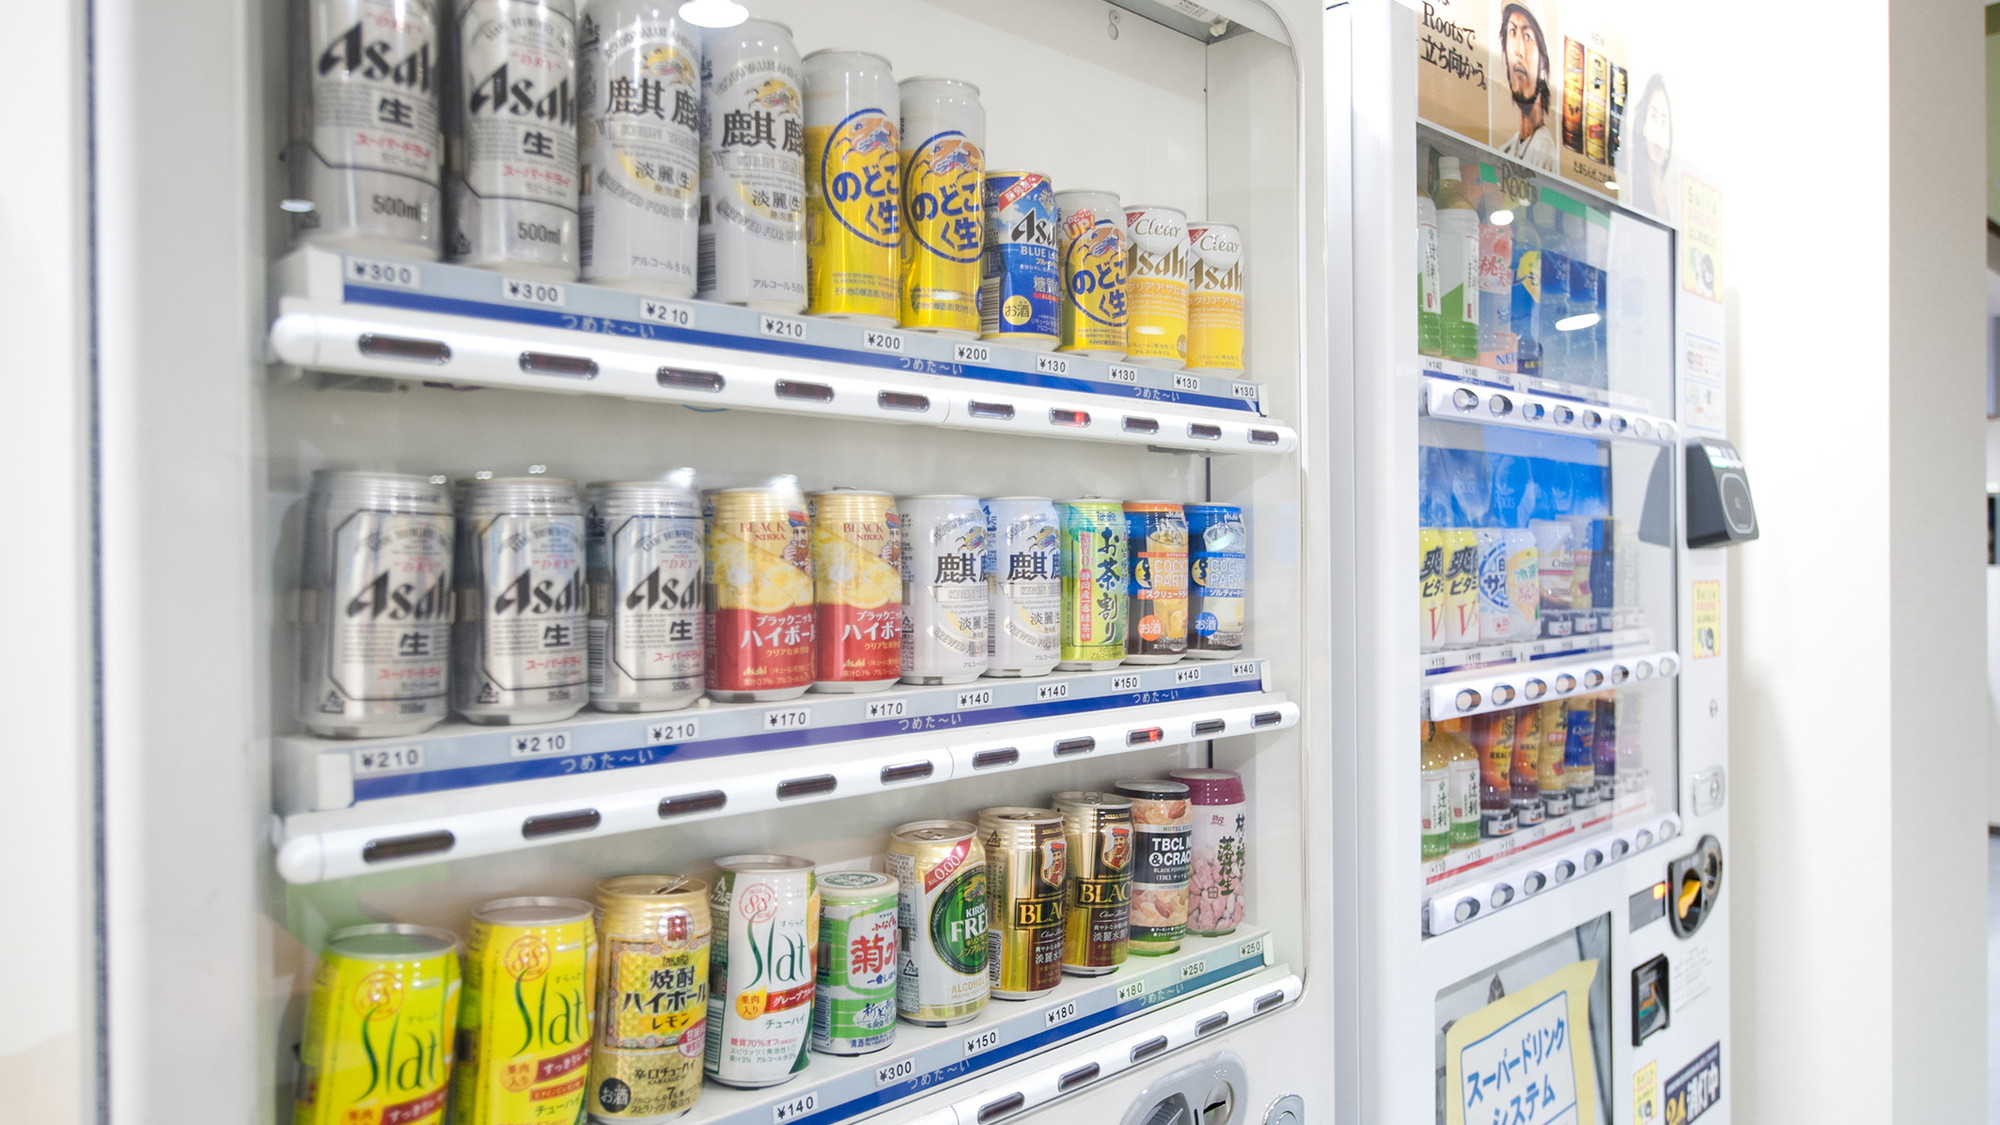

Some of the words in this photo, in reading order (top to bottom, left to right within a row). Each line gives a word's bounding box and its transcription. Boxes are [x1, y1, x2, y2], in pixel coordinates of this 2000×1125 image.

[1422, 1, 1475, 51] Rootsで
[379, 97, 414, 129] 生
[523, 131, 554, 158] 生
[372, 194, 422, 222] 500ml
[518, 222, 561, 245] 500ml
[1134, 219, 1181, 238] Clear
[1021, 246, 1046, 257] BLUE
[1200, 235, 1240, 253] Clear
[355, 262, 412, 284] ¥300
[509, 282, 558, 302] ¥300
[646, 303, 688, 325] ¥210
[1005, 304, 1030, 318] お酒
[765, 320, 803, 338] ¥210
[868, 333, 900, 350] ¥200
[958, 347, 988, 361] ¥200
[1040, 358, 1066, 373] ¥130
[1112, 368, 1135, 381] ¥130
[1176, 376, 1198, 390] ¥130
[1234, 386, 1254, 397] ¥130
[1096, 526, 1121, 645] お茶割り
[669, 620, 693, 641] 生
[1140, 622, 1161, 635] お酒
[1195, 618, 1217, 631] お酒
[399, 631, 430, 656] 生
[543, 624, 571, 648] 生
[1177, 669, 1199, 681] ¥140
[1234, 664, 1254, 674] ¥140
[1040, 685, 1066, 699] ¥140
[1114, 677, 1138, 689] ¥150
[960, 691, 990, 706] ¥140
[871, 703, 903, 716] ¥170
[770, 712, 807, 727] ¥170
[653, 723, 695, 741] ¥210
[516, 736, 566, 753] ¥210
[361, 749, 418, 768] ¥210
[1152, 838, 1184, 851] TBCL
[781, 918, 805, 928] すらっと
[743, 910, 806, 989] Slat
[1241, 942, 1261, 957] ¥250
[650, 966, 695, 990] 焼酎
[1182, 962, 1204, 977] ¥250
[622, 982, 707, 1013] ハイボール
[741, 995, 760, 1004] 果肉
[1119, 983, 1143, 1000] ¥180
[510, 967, 583, 1058] Slat
[744, 1006, 760, 1016] 入り
[1048, 1004, 1074, 1023] ¥180
[652, 1013, 691, 1031] レモン
[765, 1013, 805, 1029] チューハイ
[967, 1032, 996, 1052] ¥150
[352, 1003, 438, 1103] Slat
[879, 1062, 912, 1082] ¥300
[1467, 1017, 1565, 1109] スーパードリンク
[601, 1084, 628, 1106] お酒
[777, 1097, 813, 1120] ¥140
